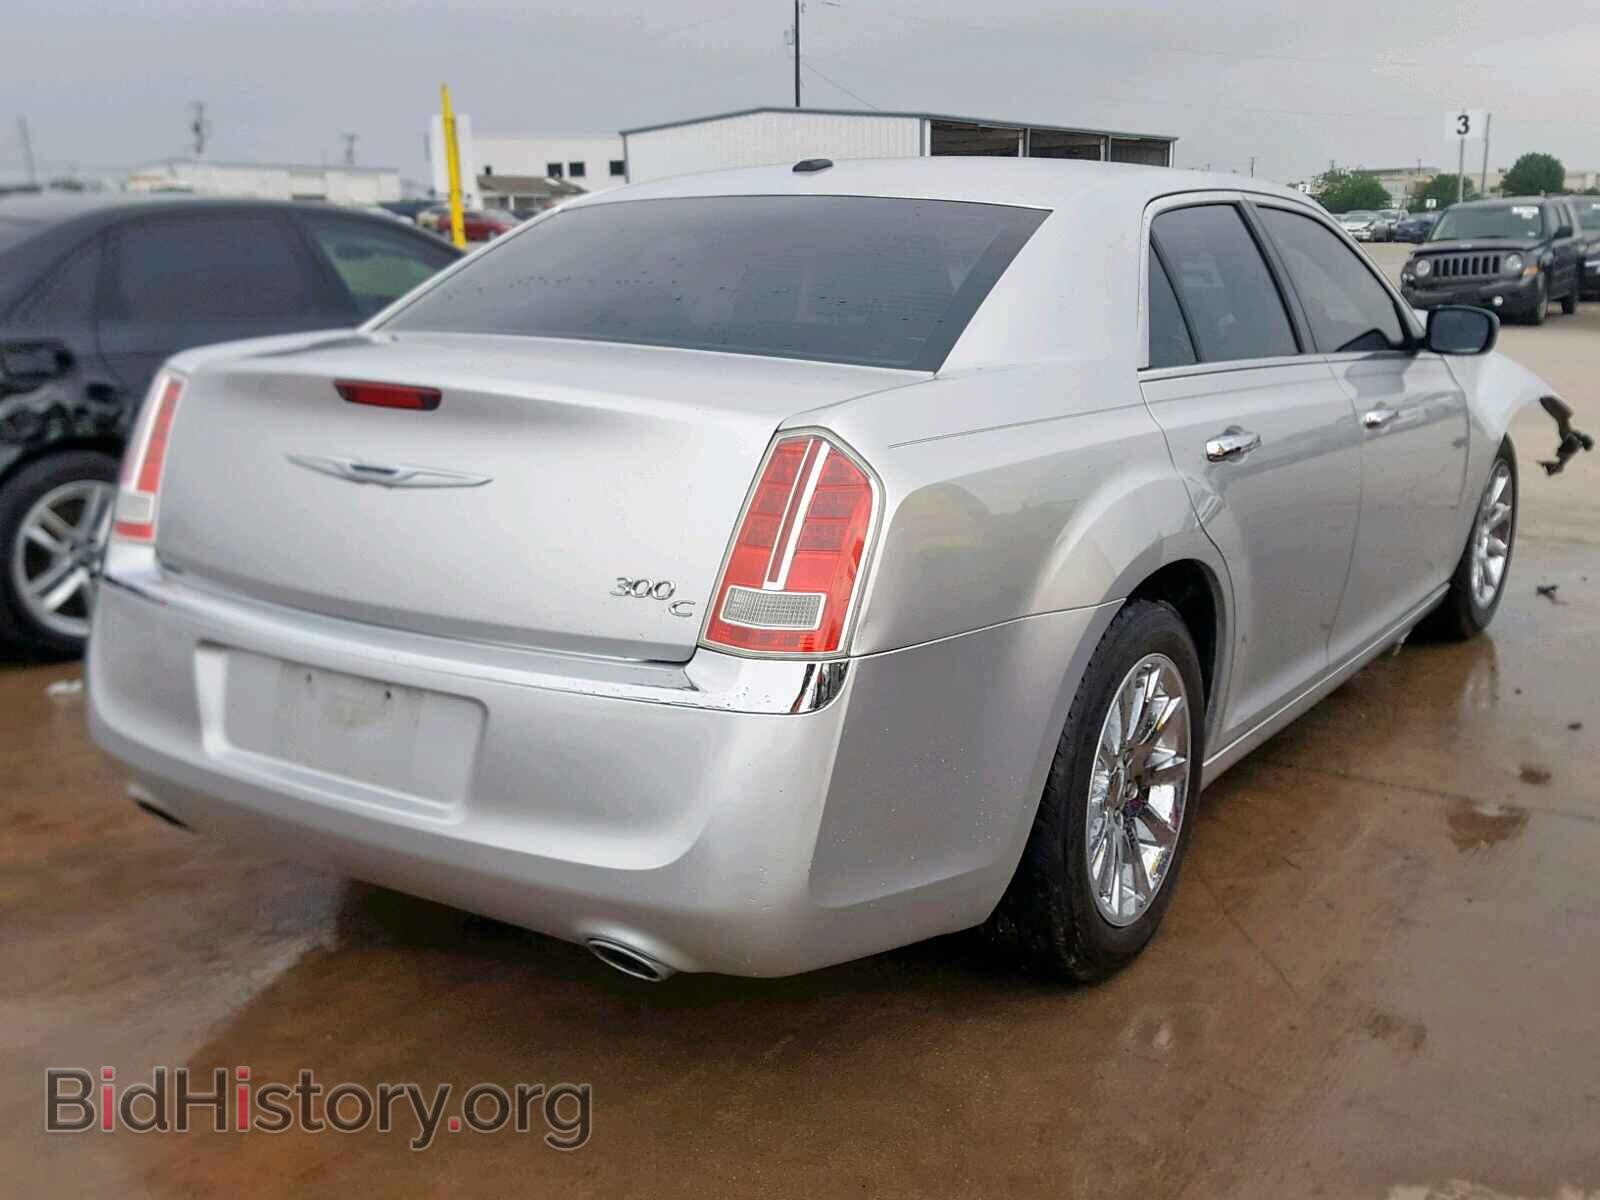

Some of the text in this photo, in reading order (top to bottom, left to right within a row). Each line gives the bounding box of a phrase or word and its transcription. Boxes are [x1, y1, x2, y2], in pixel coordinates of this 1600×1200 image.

[1456, 114, 1470, 135] 3
[609, 577, 696, 618] 300 C
